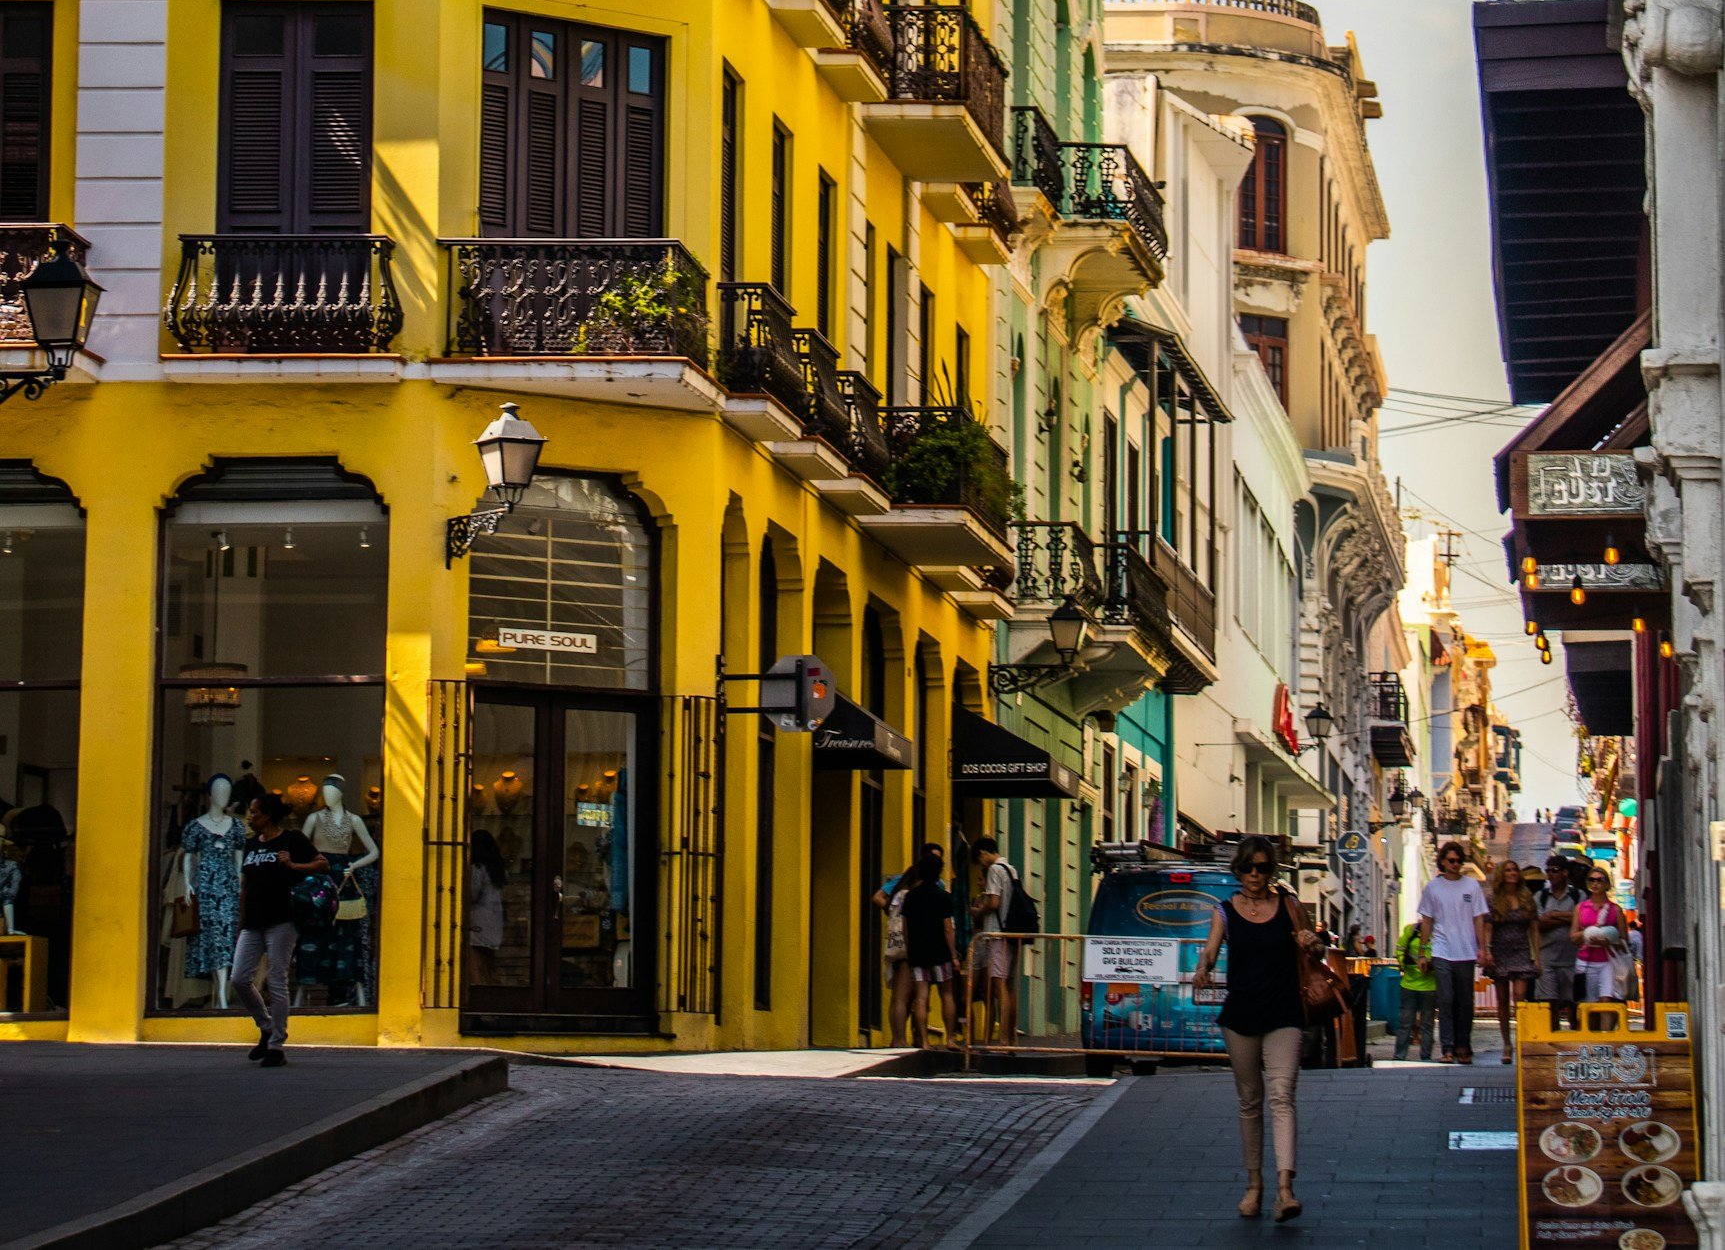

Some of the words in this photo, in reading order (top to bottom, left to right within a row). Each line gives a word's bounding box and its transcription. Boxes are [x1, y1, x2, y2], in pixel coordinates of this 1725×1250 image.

[503, 632, 546, 646] PURE
[550, 635, 593, 649] SOUL
[814, 729, 876, 749] Treasures
[962, 763, 979, 774] DOS
[980, 763, 1007, 773] COCOS
[1008, 762, 1025, 773] GIFT
[1026, 762, 1048, 773] SHOP
[1102, 947, 1120, 955] SOLO
[1123, 948, 1163, 957] VEHICULOS
[1118, 958, 1154, 967] BUILDERS
[1578, 1044, 1591, 1061] A
[1592, 1044, 1615, 1061] TU
